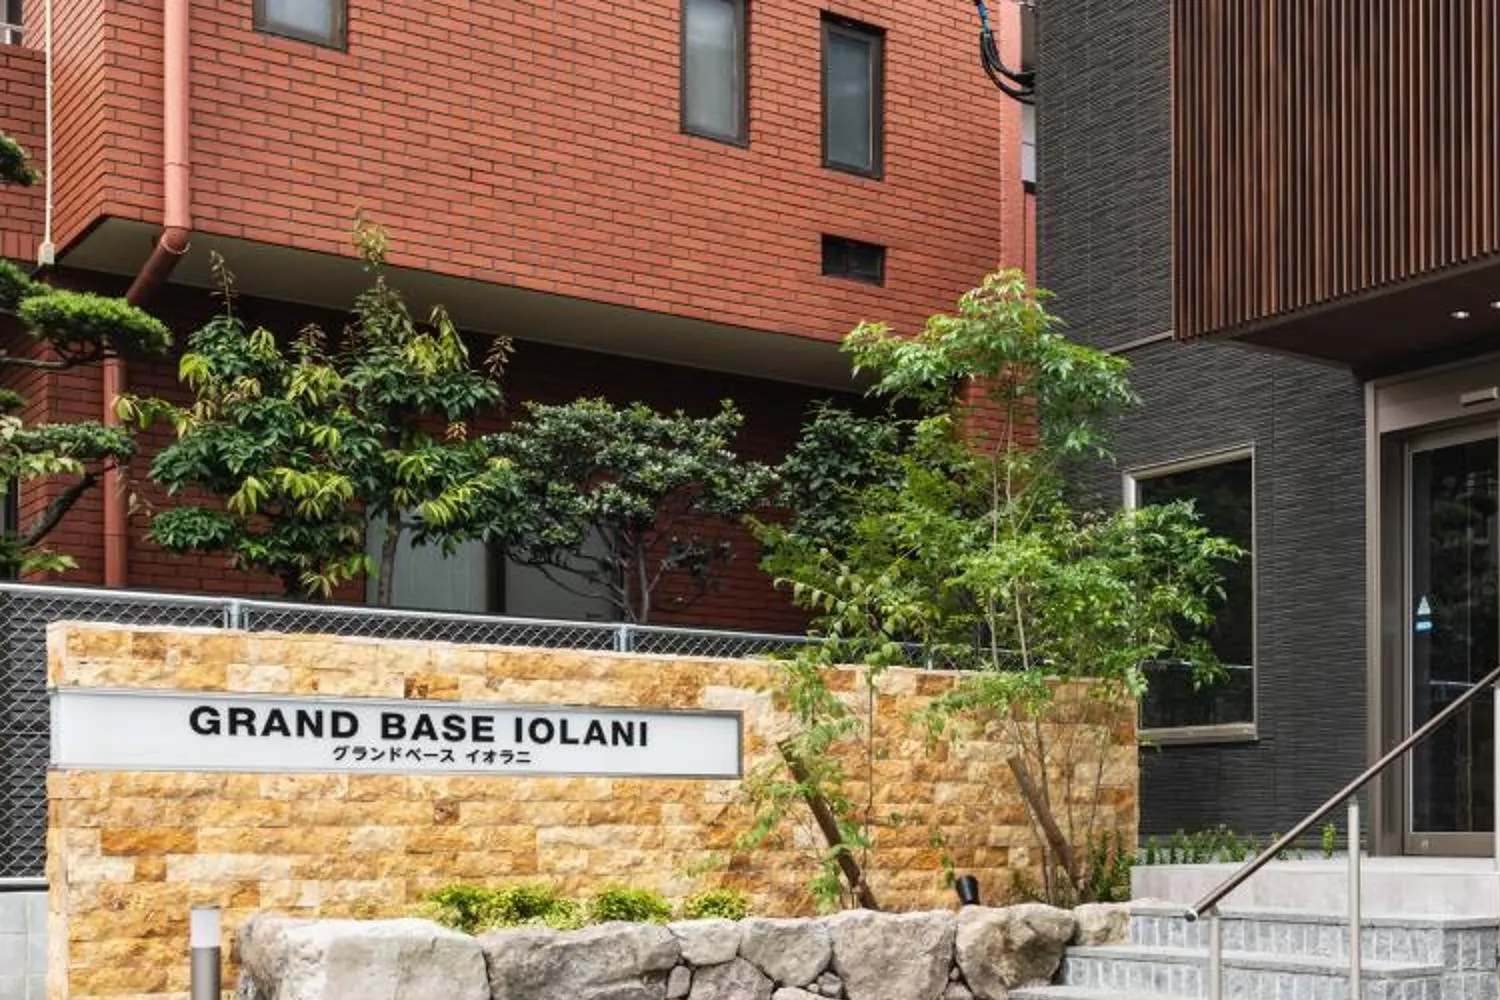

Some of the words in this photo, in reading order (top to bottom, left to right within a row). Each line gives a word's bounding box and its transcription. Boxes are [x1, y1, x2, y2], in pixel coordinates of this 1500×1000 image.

[188, 705, 360, 739] GRAND
[380, 711, 496, 743] BASE
[514, 716, 648, 748] IOLANI
[332, 745, 456, 764] グランドベース
[465, 748, 532, 765] イオラニ
